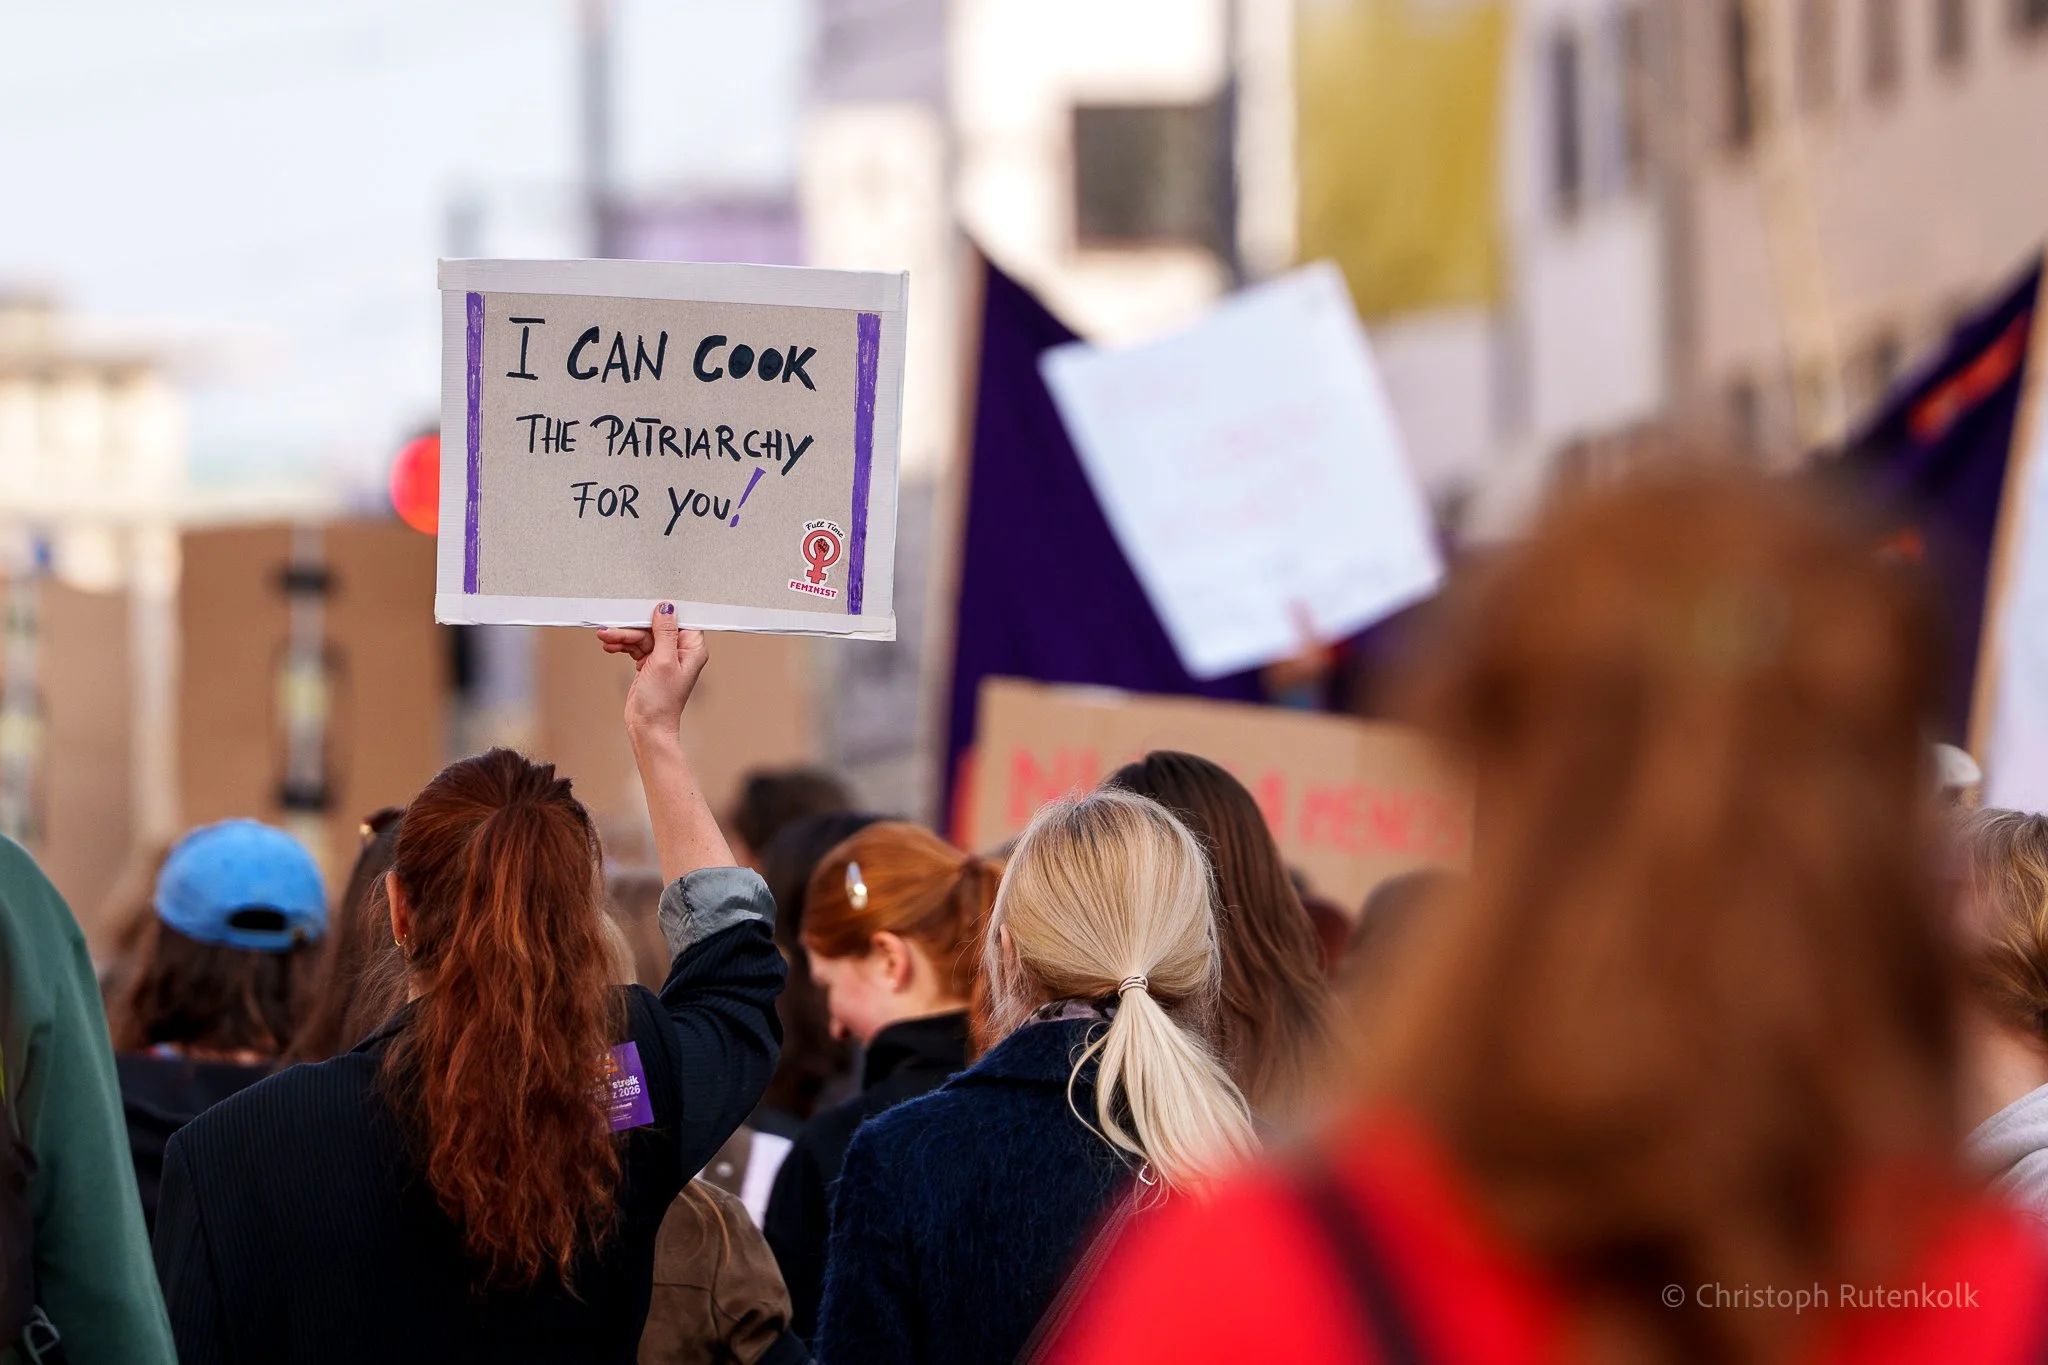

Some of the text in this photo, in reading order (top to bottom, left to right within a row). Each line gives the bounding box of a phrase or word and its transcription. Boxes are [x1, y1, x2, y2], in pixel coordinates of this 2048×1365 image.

[506, 317, 818, 392] I CAN COOK
[515, 413, 815, 477] THE PATRIARCHY
[570, 481, 640, 519] FOR
[805, 521, 844, 539] Full Time
[790, 581, 837, 598] FEMINIST
[612, 1075, 640, 1089] streik
[619, 1085, 641, 1098] 2026
